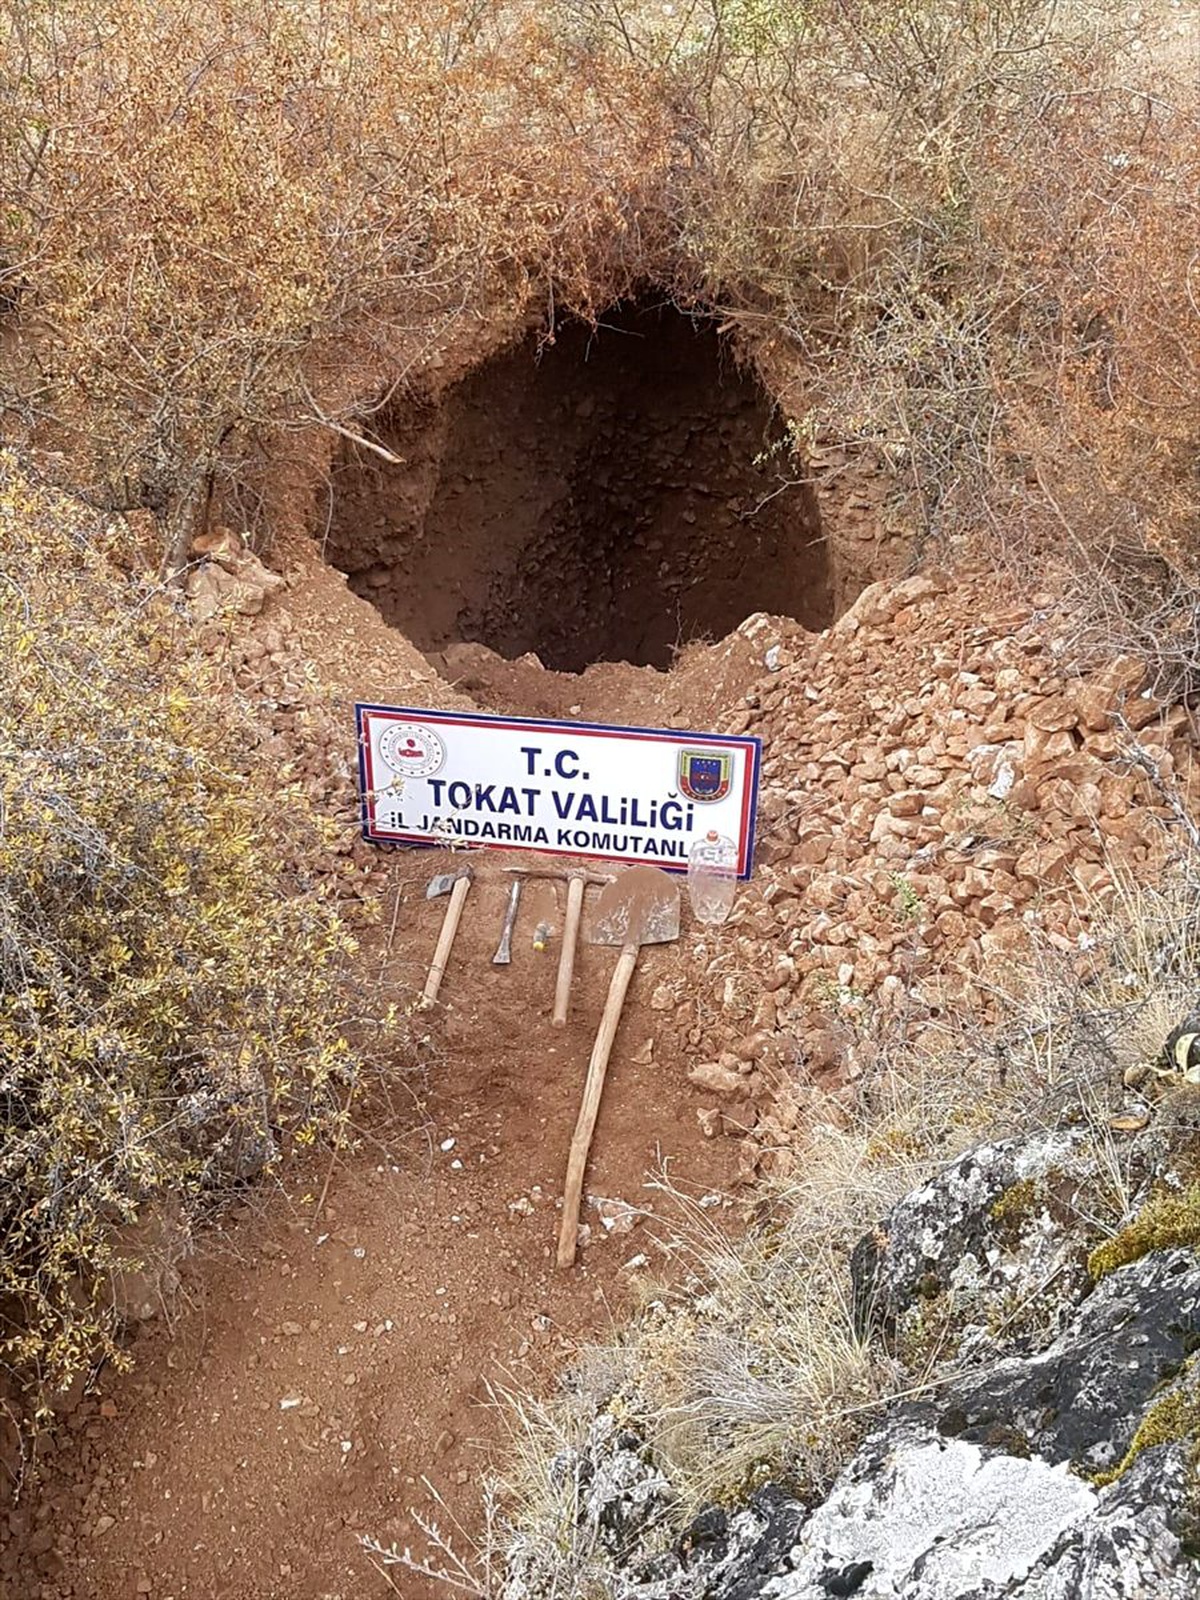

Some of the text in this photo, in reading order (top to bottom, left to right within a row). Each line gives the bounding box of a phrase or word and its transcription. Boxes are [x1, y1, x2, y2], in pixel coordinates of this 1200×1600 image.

[520, 747, 590, 781] T.C.
[427, 779, 541, 817] TOKAT
[416, 815, 549, 845] JANDARMA
[556, 829, 690, 858] KOMUTANL
